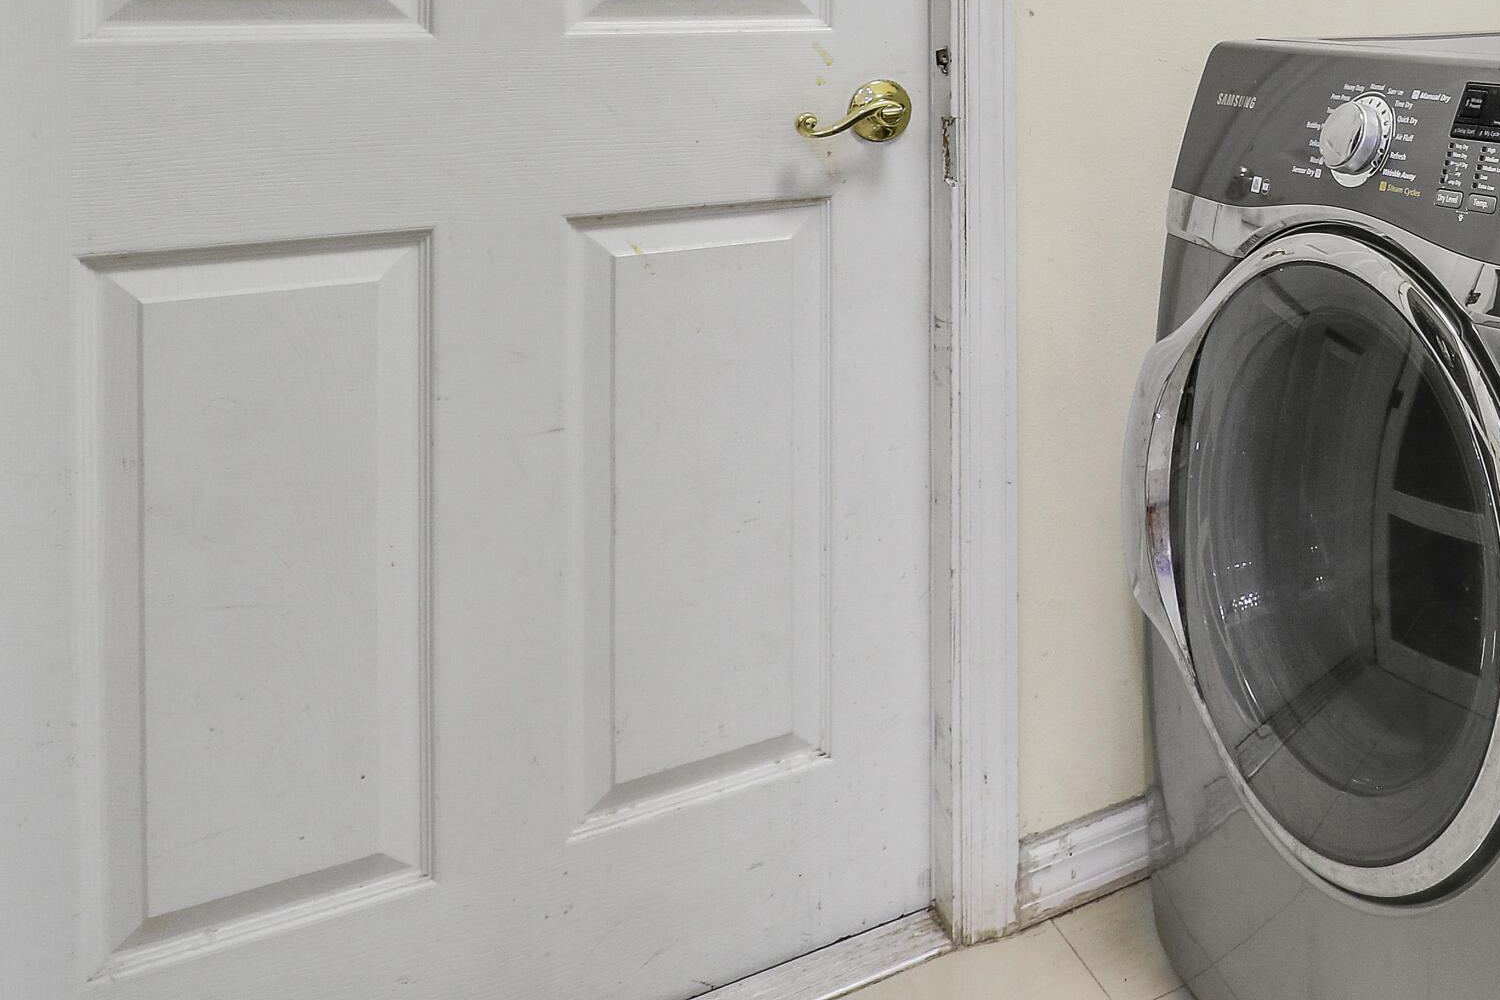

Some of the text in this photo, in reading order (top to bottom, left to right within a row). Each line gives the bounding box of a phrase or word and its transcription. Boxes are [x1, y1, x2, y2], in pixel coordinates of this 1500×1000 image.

[1216, 92, 1257, 109] SAMSUNG
[1420, 92, 1452, 104] Manual Dry
[1405, 101, 1414, 111] Dry
[1409, 117, 1419, 127] Dry
[1306, 168, 1315, 177] Dry
[1386, 183, 1421, 197] Steam Cycles
[1437, 193, 1459, 205] Dry Level
[1473, 198, 1489, 209] Temp.
